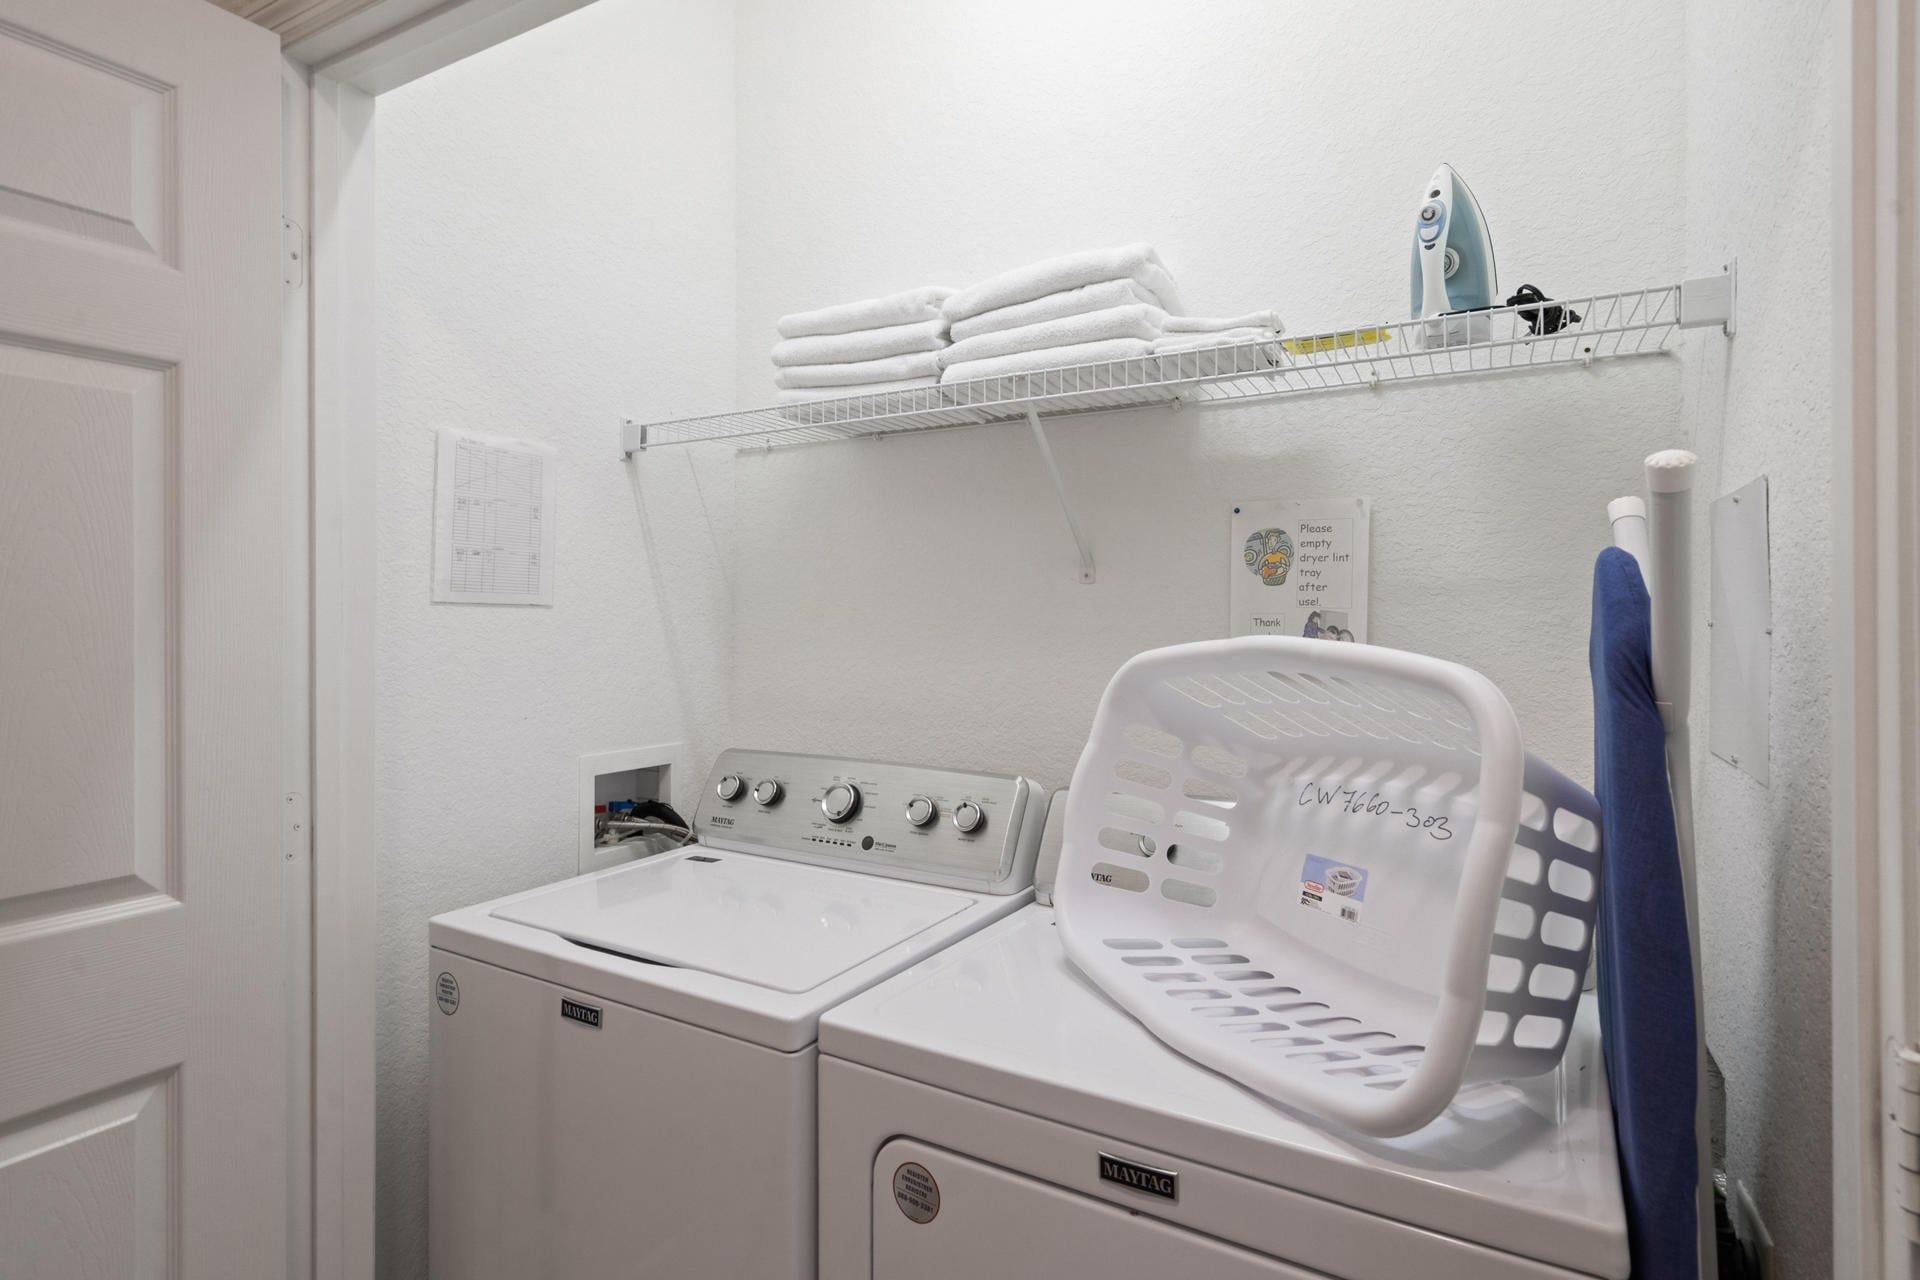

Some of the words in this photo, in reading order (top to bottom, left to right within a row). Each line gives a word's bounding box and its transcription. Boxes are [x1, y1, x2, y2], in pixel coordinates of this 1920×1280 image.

[1300, 524, 1333, 533] Please
[1300, 539, 1332, 549] empty
[1300, 553, 1329, 564] dryer
[1333, 553, 1349, 562] lint
[1300, 569, 1322, 579] tray
[1298, 583, 1328, 592] after
[1298, 598, 1320, 607] use!
[1252, 617, 1281, 627] Thank
[711, 816, 736, 825] MAYTAG
[563, 1003, 598, 1023] MAYTAG
[1103, 1161, 1171, 1193] MAYTAG
